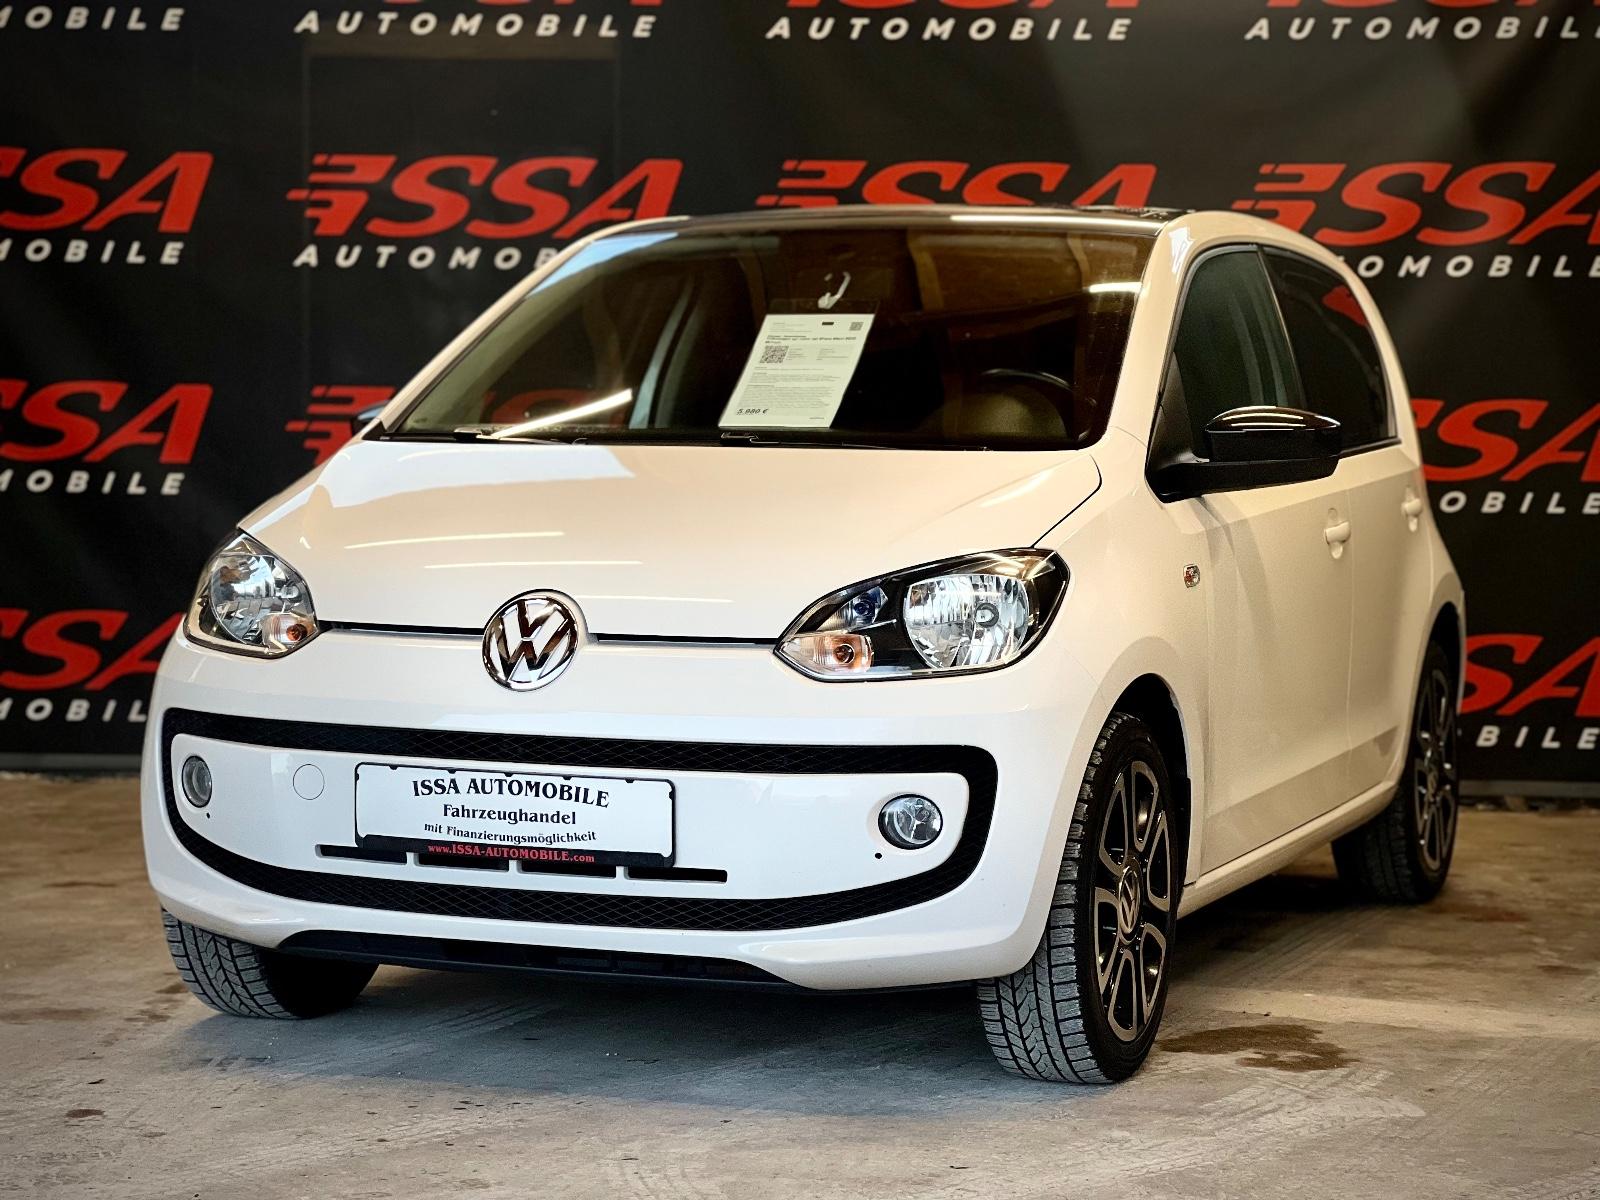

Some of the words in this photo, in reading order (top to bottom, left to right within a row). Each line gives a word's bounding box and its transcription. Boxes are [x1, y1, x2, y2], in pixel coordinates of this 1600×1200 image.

[294, 10, 656, 38] AUTOMOBILE
[765, 16, 1132, 41] AUTOMOBILE
[1244, 16, 1600, 40] AUTOMOBIL
[292, 243, 559, 270] AUTOMOB
[1439, 490, 1600, 515] OBILE
[0, 696, 147, 722] OBIL
[412, 777, 460, 797] ISSA
[467, 778, 610, 808] AUTOMOBILE
[443, 803, 576, 825] Fahrzeughandel
[424, 823, 443, 834] mit
[446, 825, 597, 846] Finanzierungsmöglichkeit
[427, 843, 596, 864] www.ISSA-AUTOMOBILE.com
